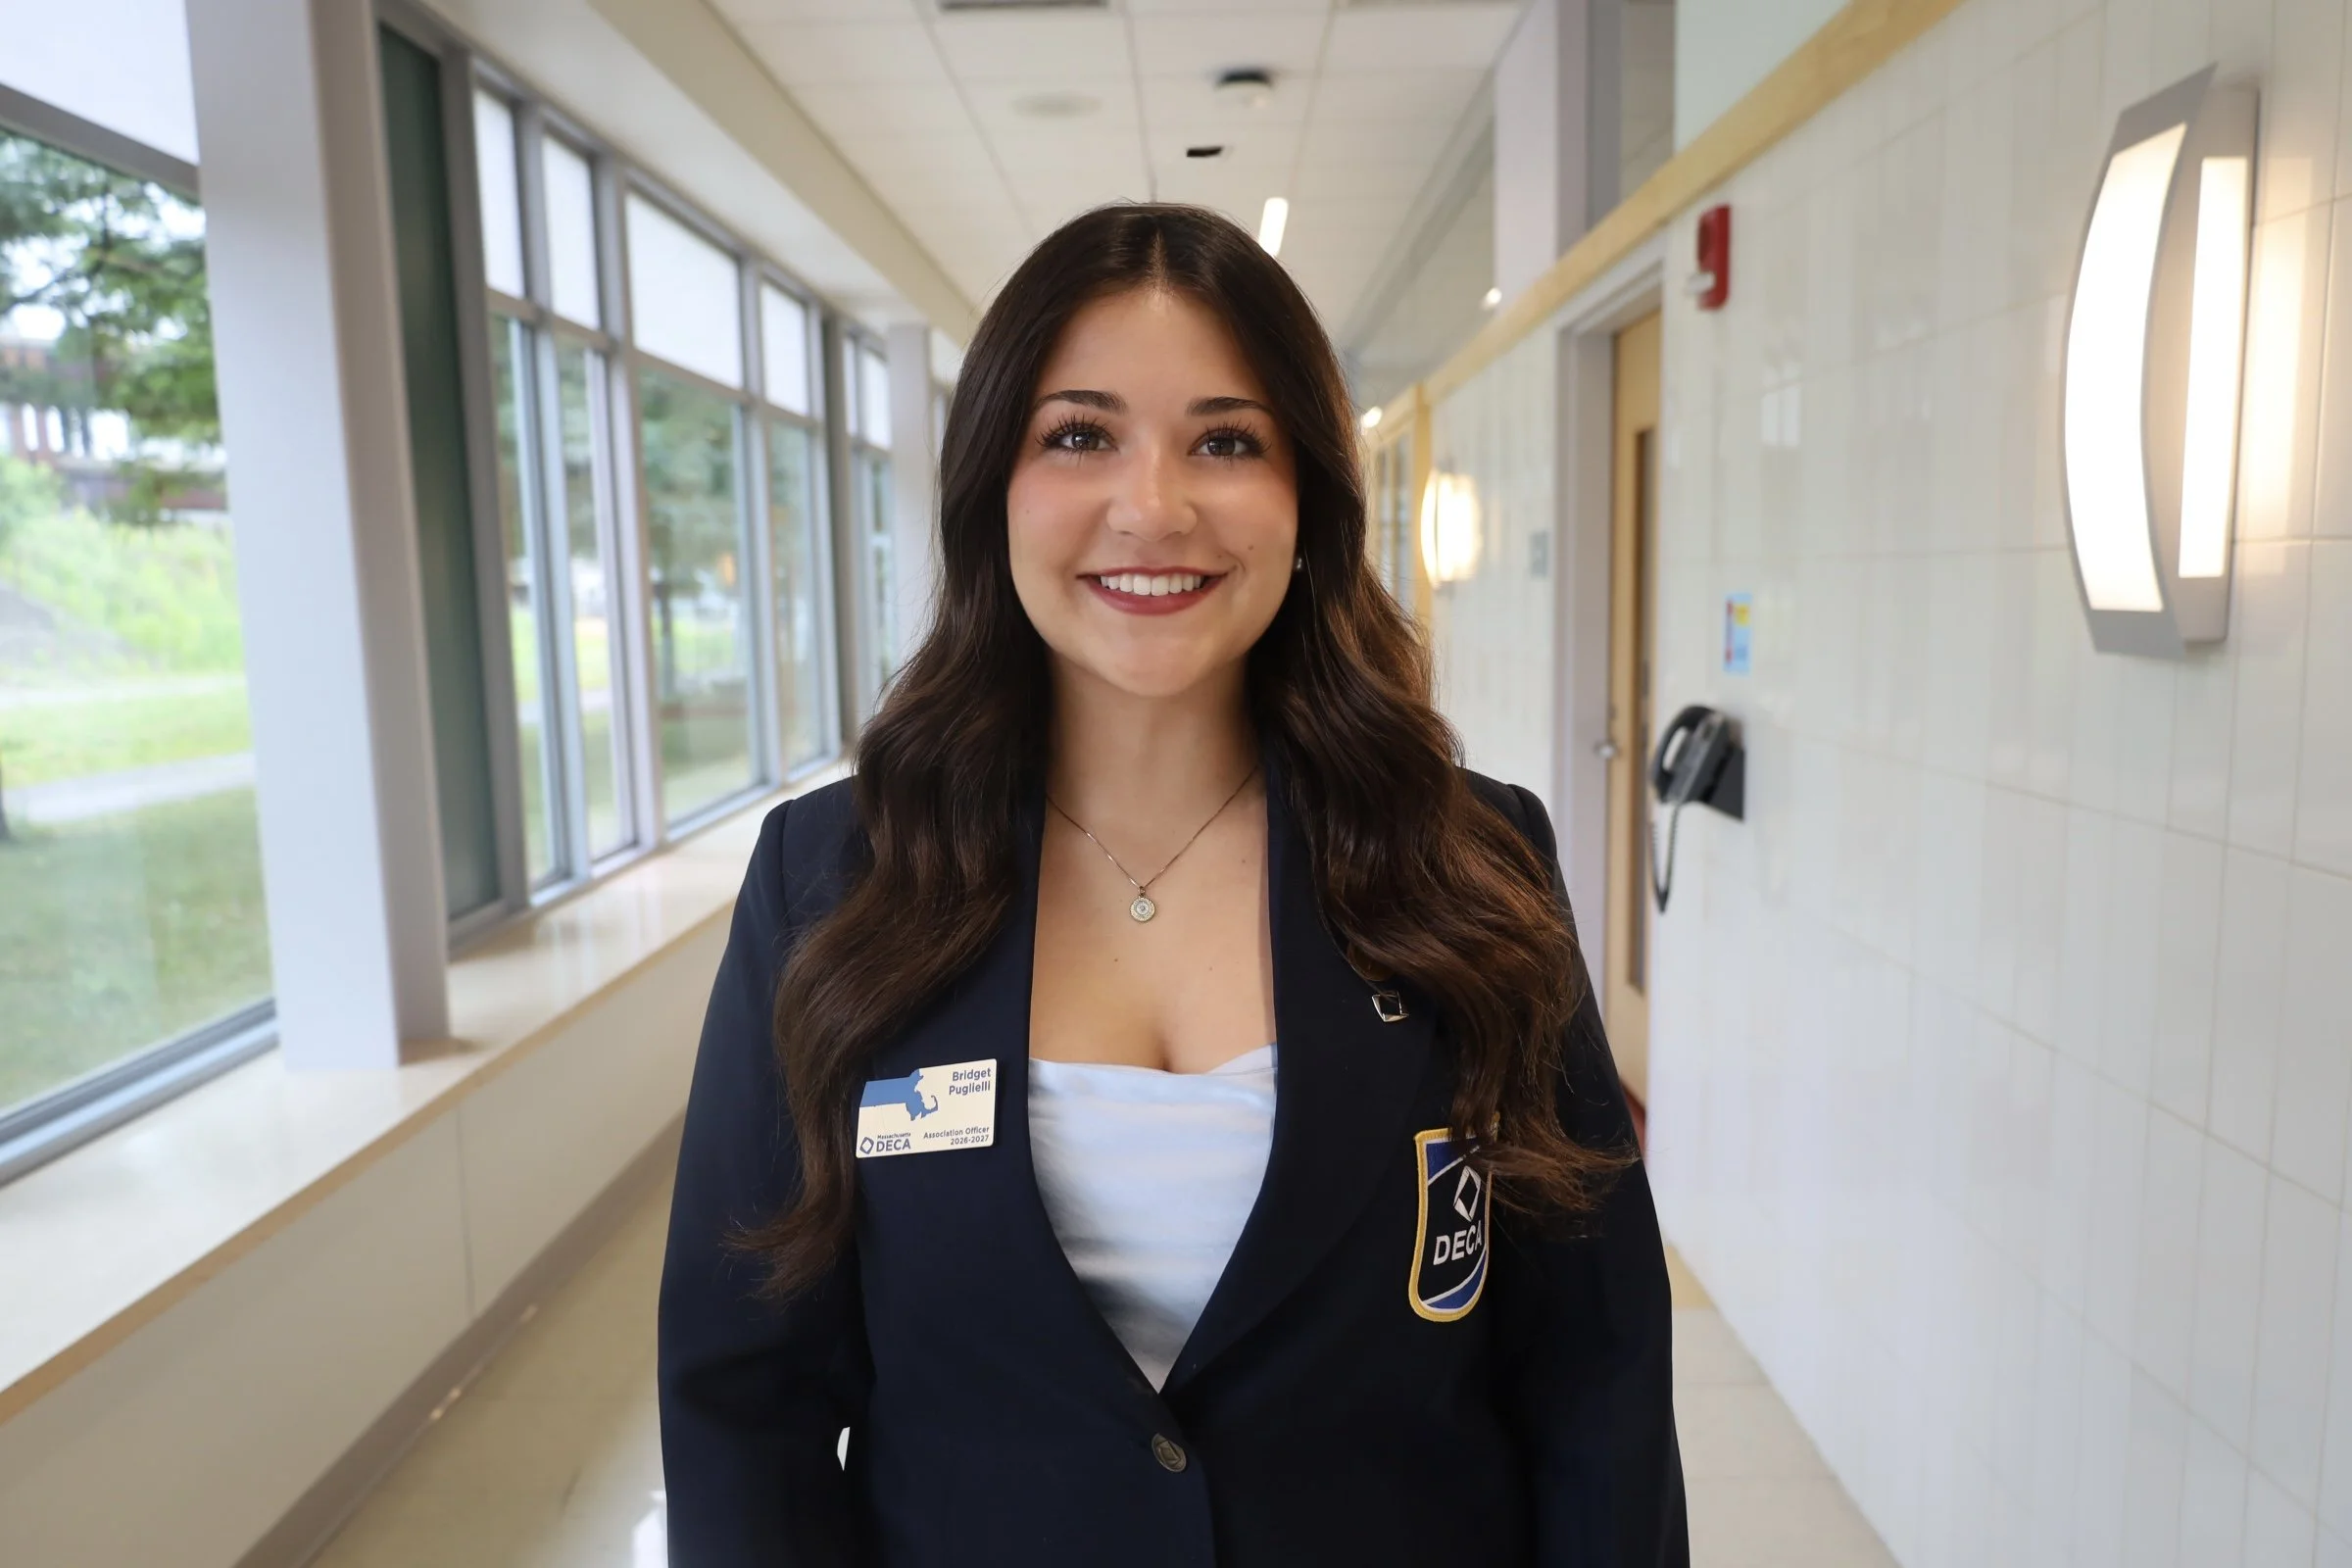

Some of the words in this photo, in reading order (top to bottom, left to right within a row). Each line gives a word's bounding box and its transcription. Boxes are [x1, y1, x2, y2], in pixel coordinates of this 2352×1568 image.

[953, 1067, 991, 1081] Bridget
[949, 1080, 991, 1096] Puglielli
[923, 1128, 963, 1139] Association
[965, 1125, 990, 1135] Officer
[876, 1138, 911, 1152] DECA
[951, 1134, 990, 1146] 2026-2027
[1433, 1220, 1482, 1265] DECA
